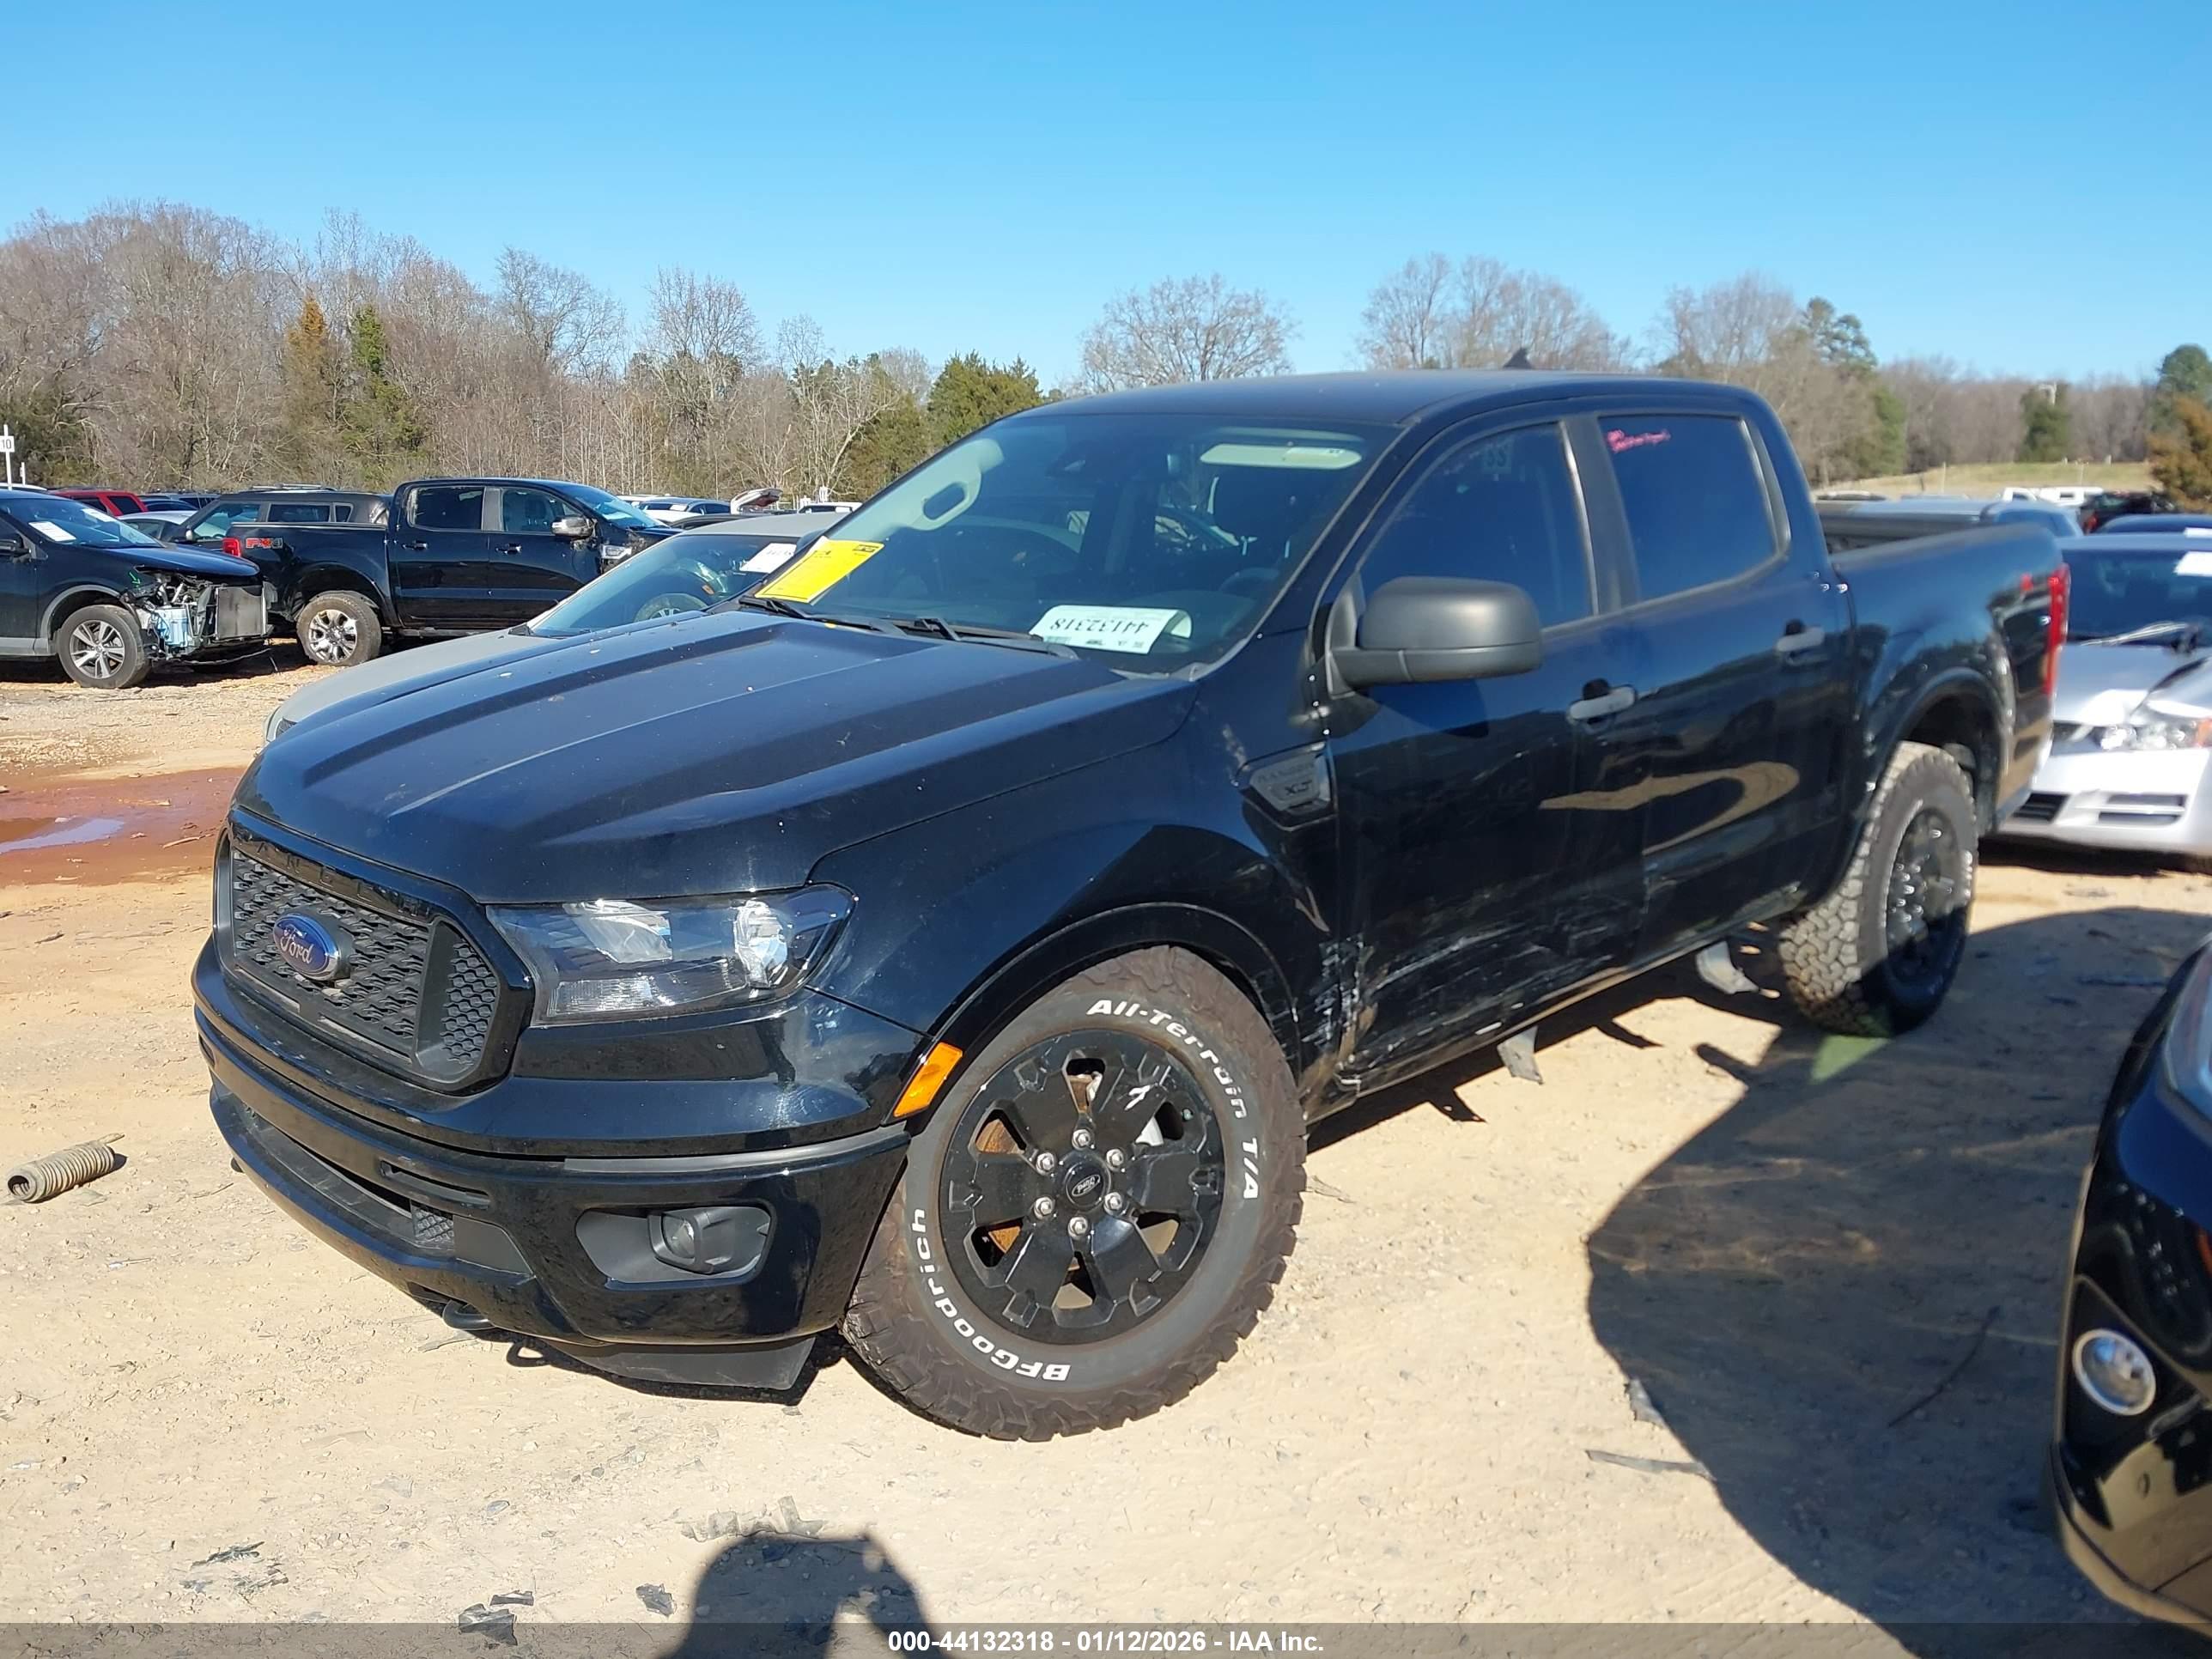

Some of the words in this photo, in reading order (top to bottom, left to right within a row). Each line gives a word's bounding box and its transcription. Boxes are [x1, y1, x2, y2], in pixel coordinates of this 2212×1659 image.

[1050, 617, 1150, 634] 44132318
[280, 924, 314, 963] Ford
[1086, 1000, 1248, 1119] All-Terrain
[1242, 1137, 1259, 1199] T/A
[911, 1208, 1072, 1381] BFGoodrich
